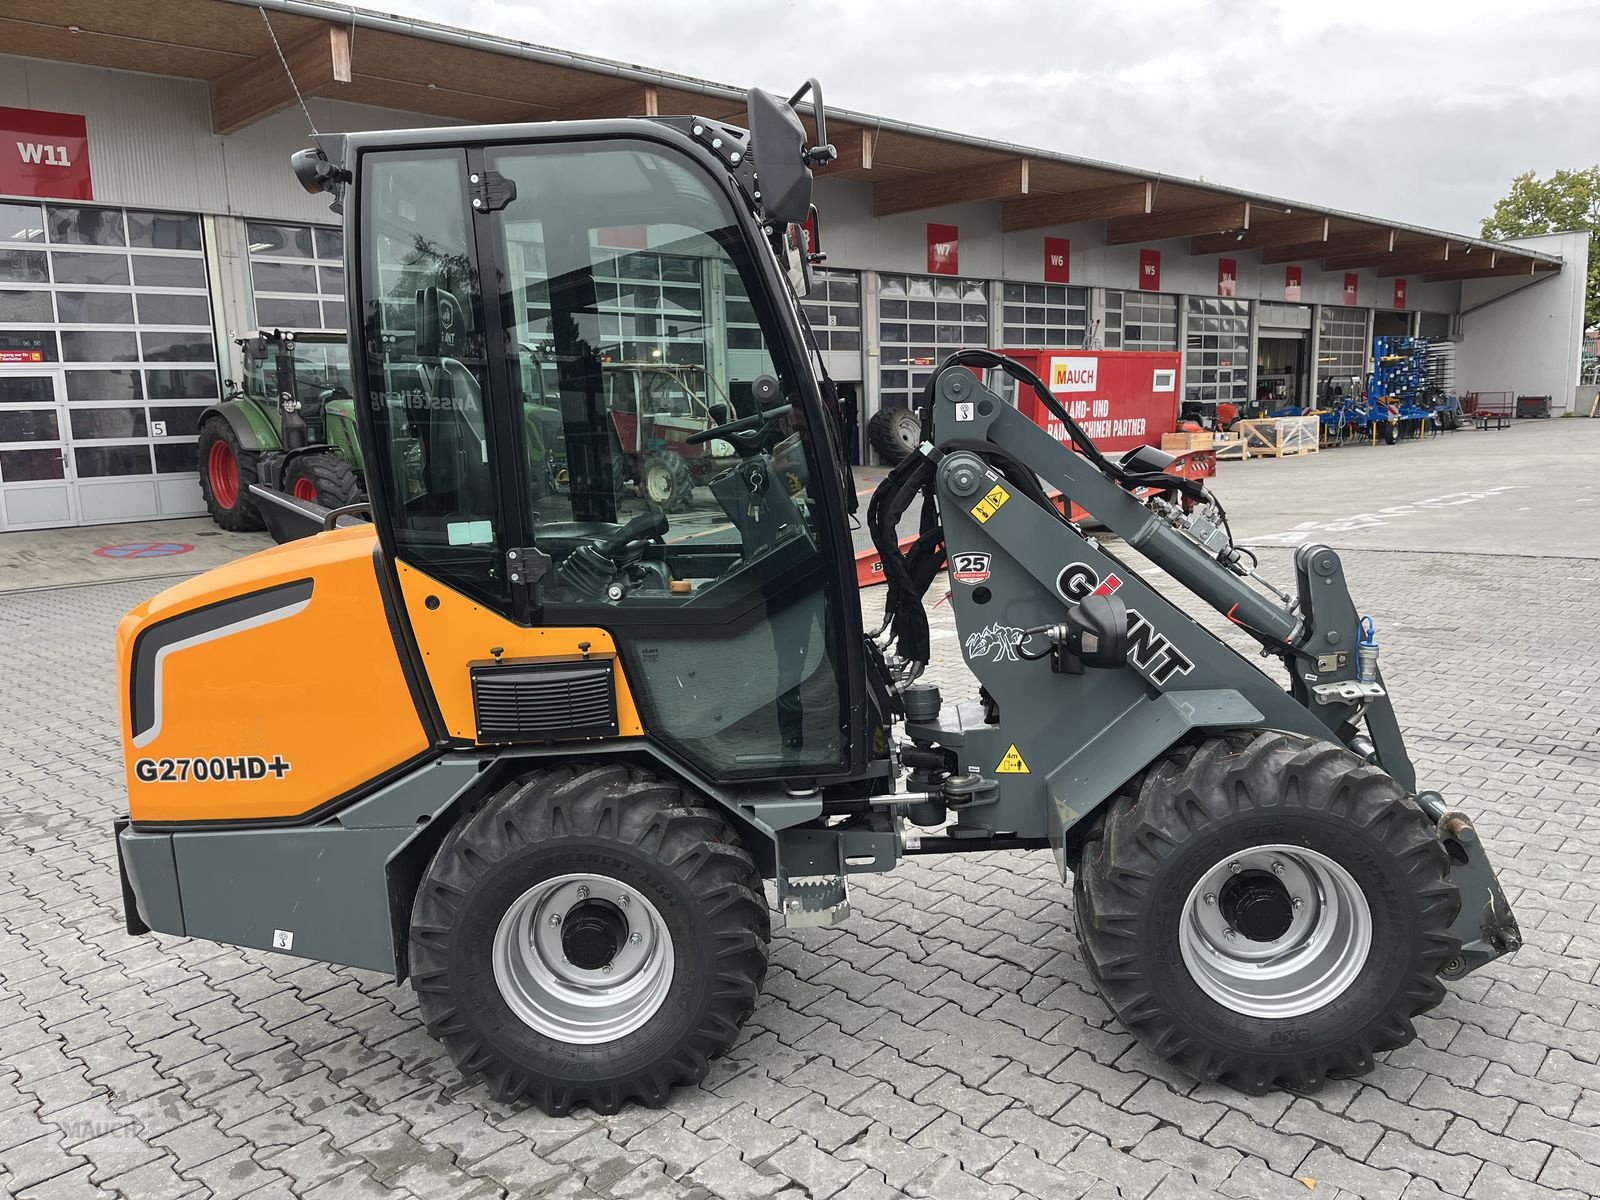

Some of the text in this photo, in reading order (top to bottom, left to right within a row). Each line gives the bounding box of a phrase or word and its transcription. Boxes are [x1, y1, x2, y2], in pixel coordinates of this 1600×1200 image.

[16, 142, 71, 167] W11
[936, 243, 950, 256] W7
[1050, 254, 1064, 267] W6
[1145, 265, 1156, 276] W5
[1057, 370, 1094, 385] MAUCH
[1092, 400, 1109, 418] UND
[154, 423, 163, 436] 5
[1113, 418, 1146, 438] PARTNER
[959, 557, 986, 572] 25
[135, 755, 291, 783] G2700HD+
